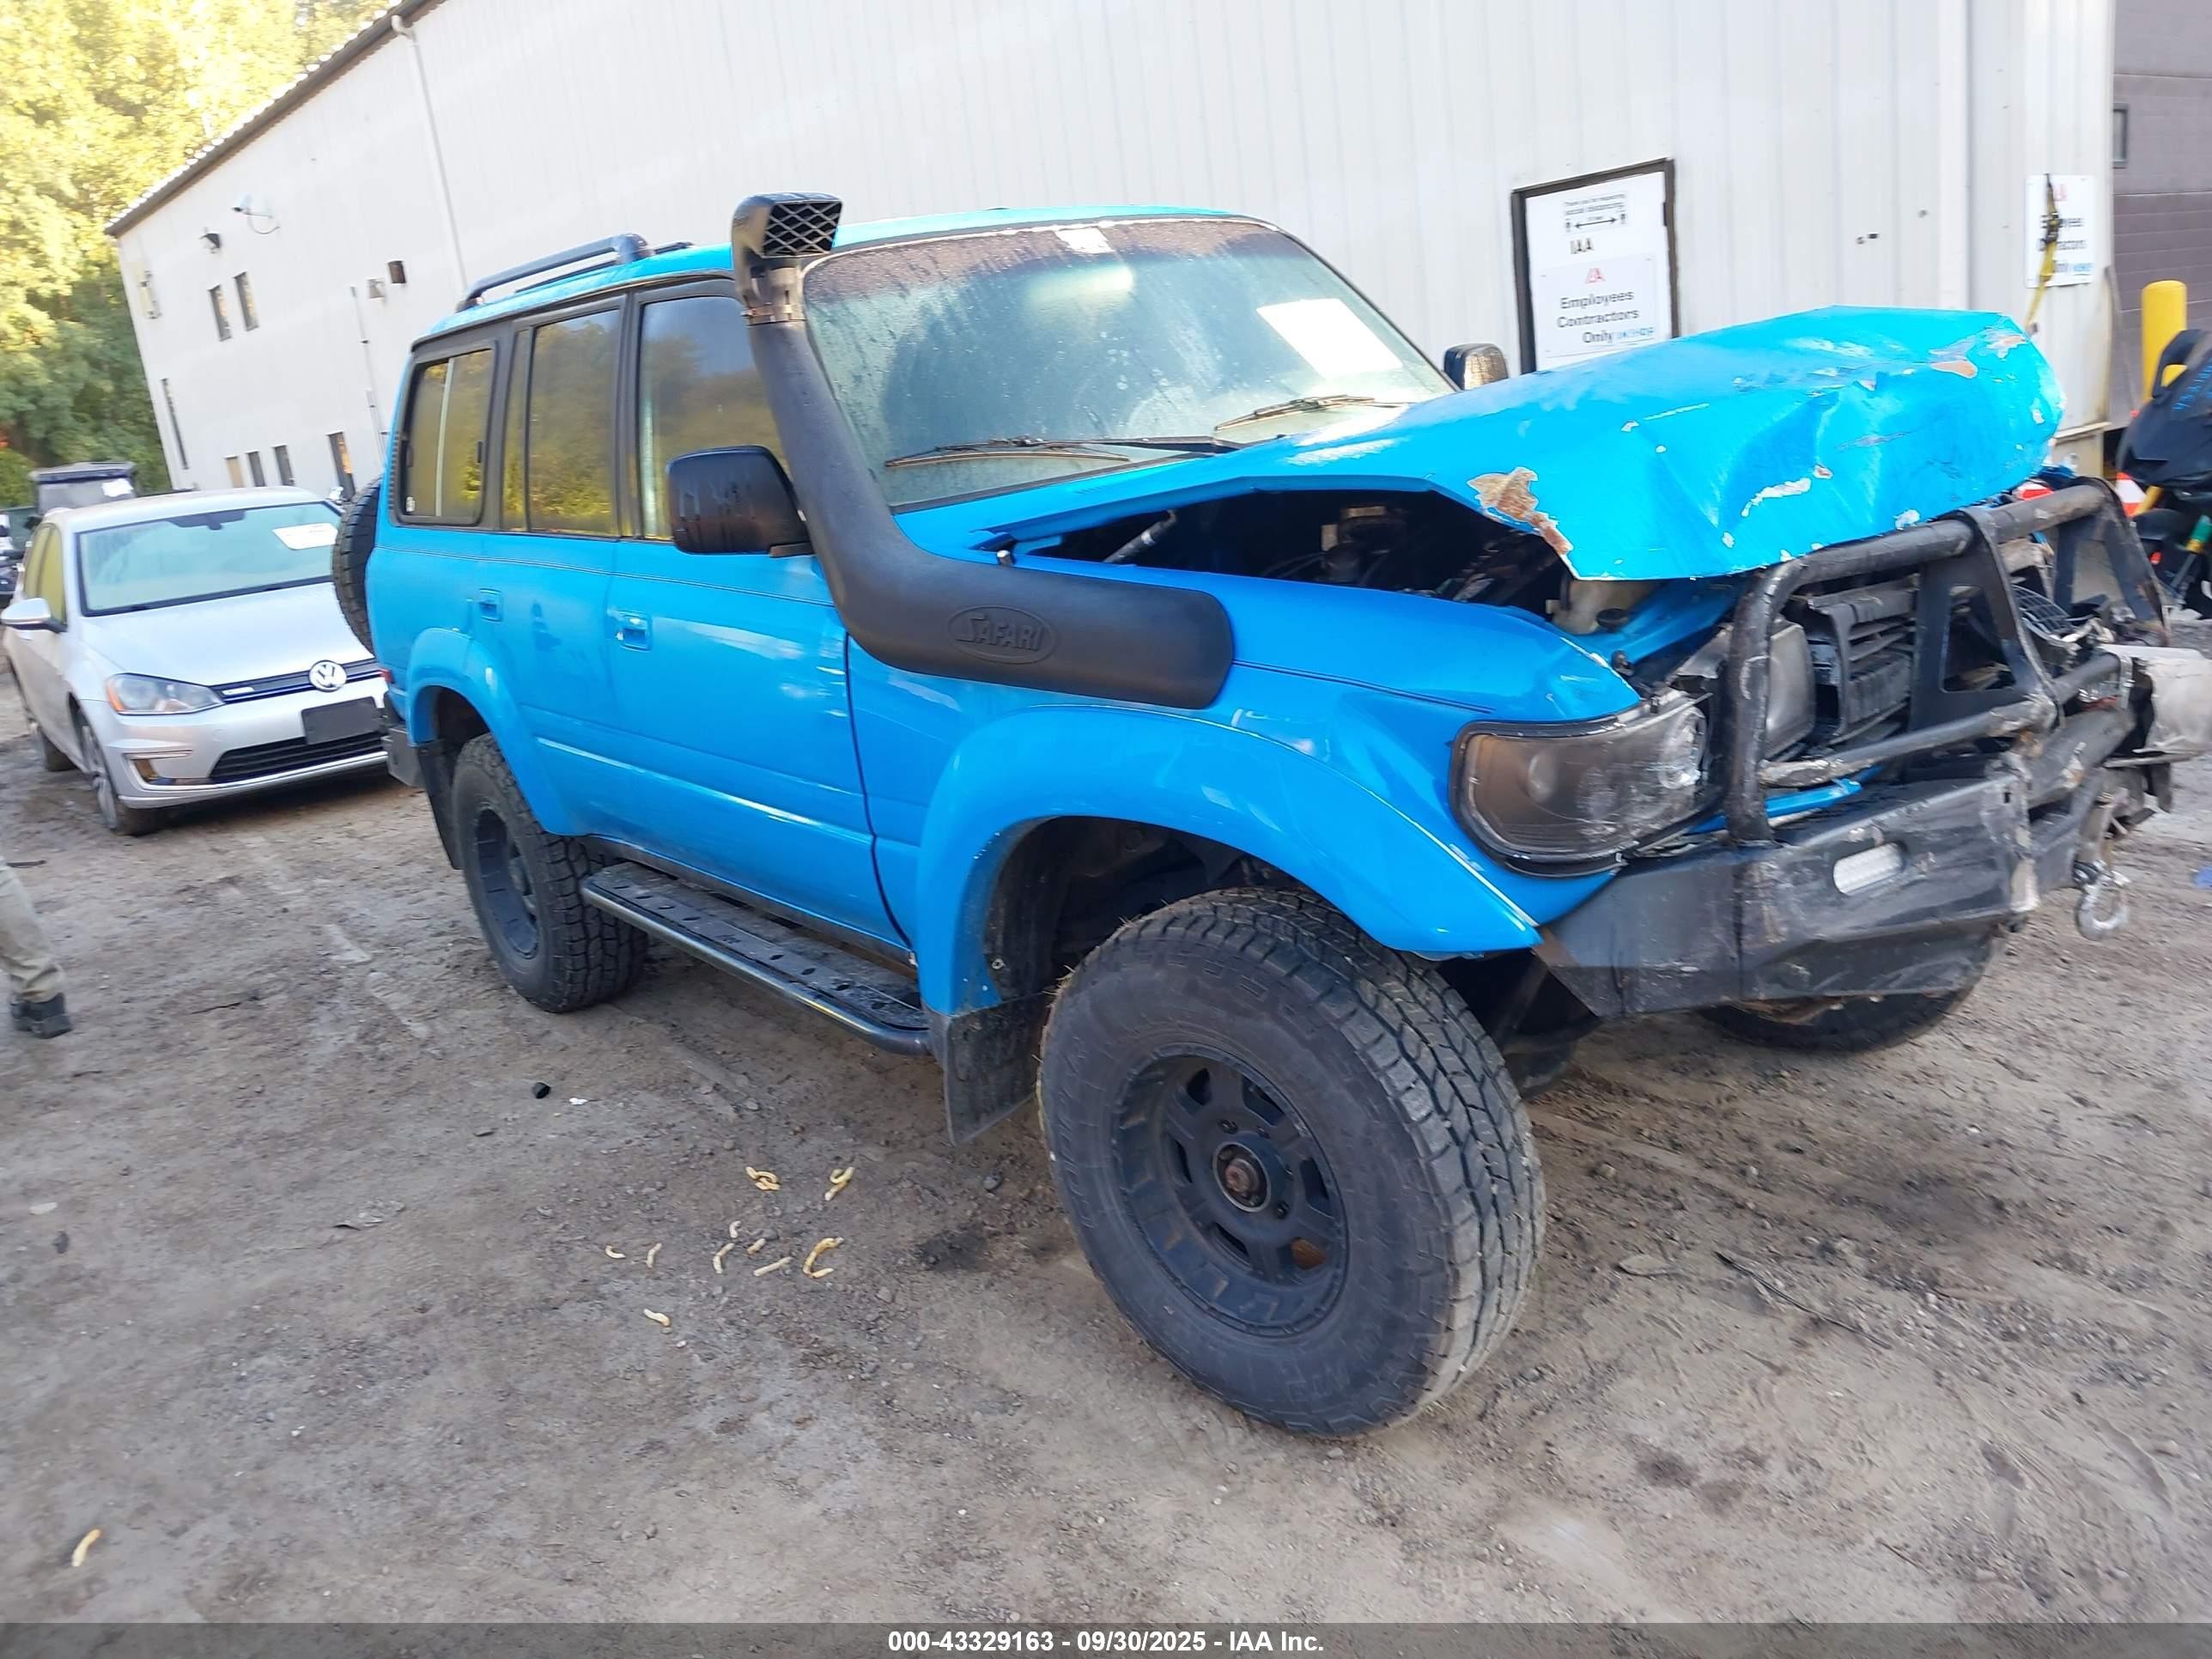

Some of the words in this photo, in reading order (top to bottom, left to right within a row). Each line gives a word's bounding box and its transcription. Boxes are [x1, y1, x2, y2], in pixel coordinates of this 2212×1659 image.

[1559, 291, 1634, 310] Employees
[1556, 310, 1639, 328] Contractors
[1582, 330, 1613, 344] Only
[954, 613, 1046, 651] SAFARI
